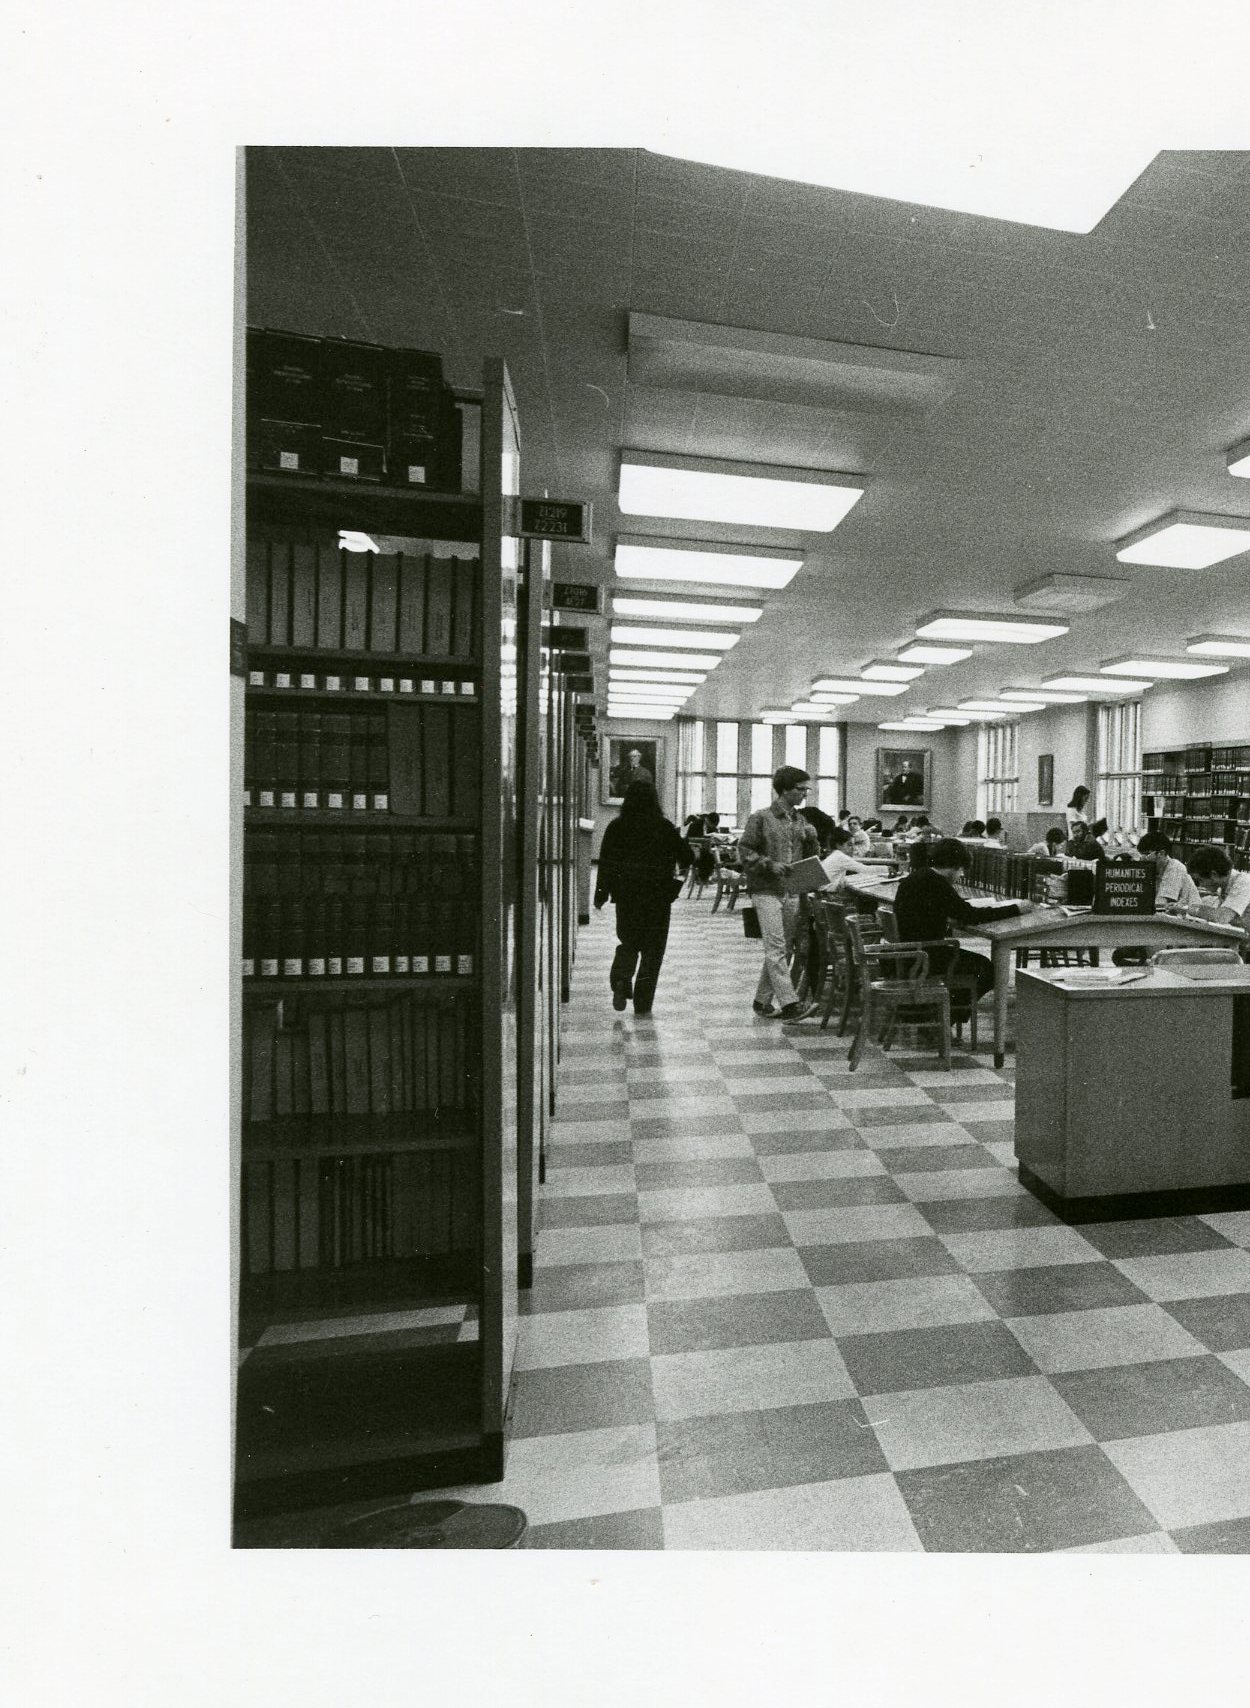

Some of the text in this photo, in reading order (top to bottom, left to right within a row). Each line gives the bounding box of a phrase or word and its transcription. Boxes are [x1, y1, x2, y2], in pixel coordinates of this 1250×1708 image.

[1105, 868, 1146, 878] HUMANITIES
[1105, 882, 1144, 892] PERIODICAL
[1110, 897, 1138, 907] INDEXES
